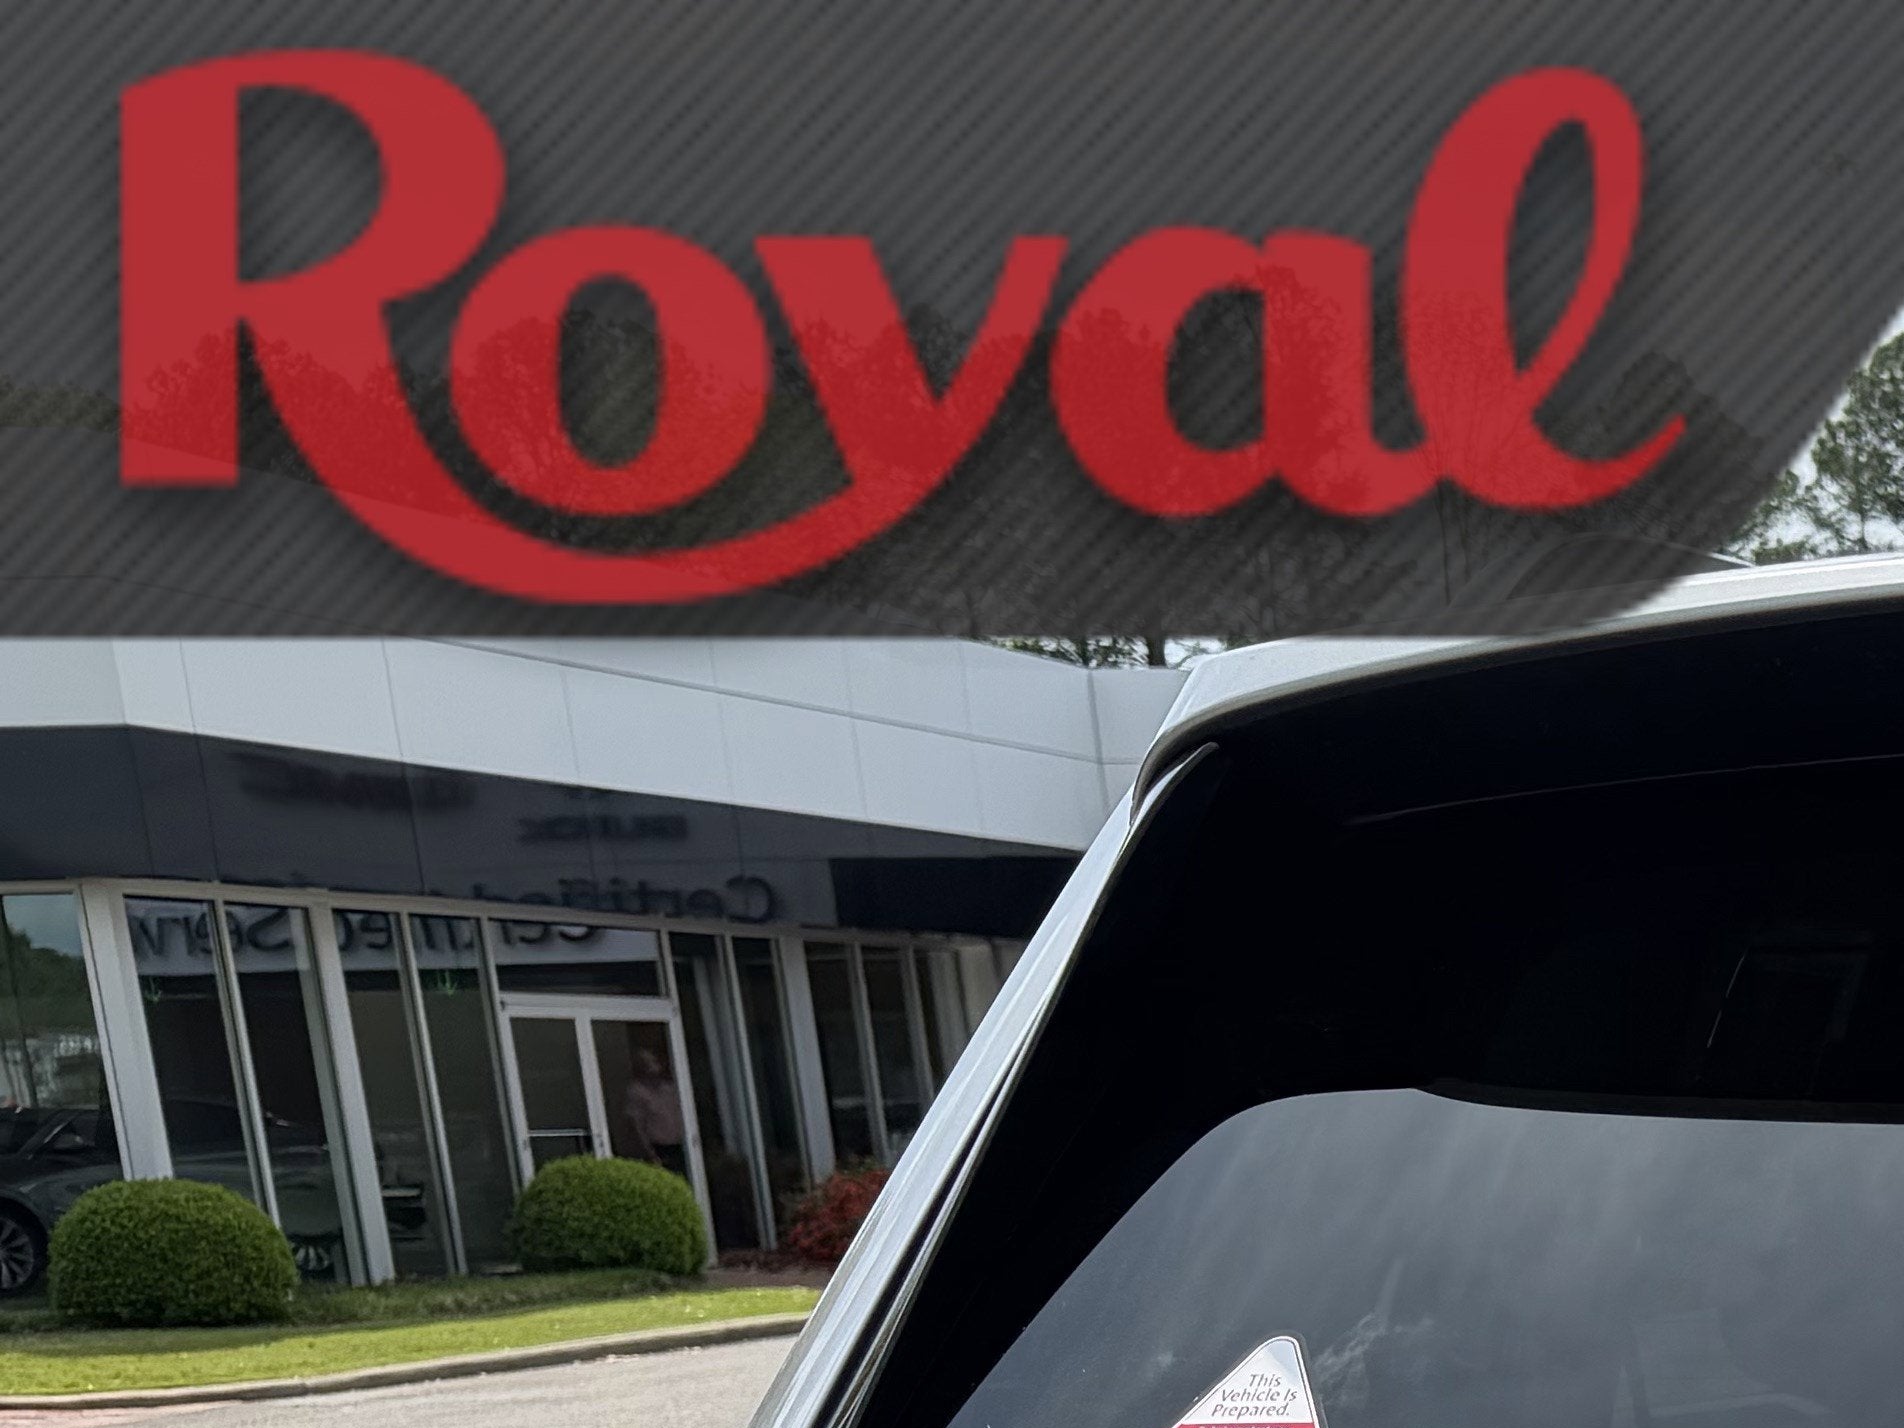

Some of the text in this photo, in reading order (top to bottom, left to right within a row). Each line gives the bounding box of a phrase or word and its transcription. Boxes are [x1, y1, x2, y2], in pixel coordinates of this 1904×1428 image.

[1248, 1373, 1282, 1388] This
[1221, 1388, 1299, 1402] Vehicle Is
[1211, 1402, 1291, 1419] Prepared.
